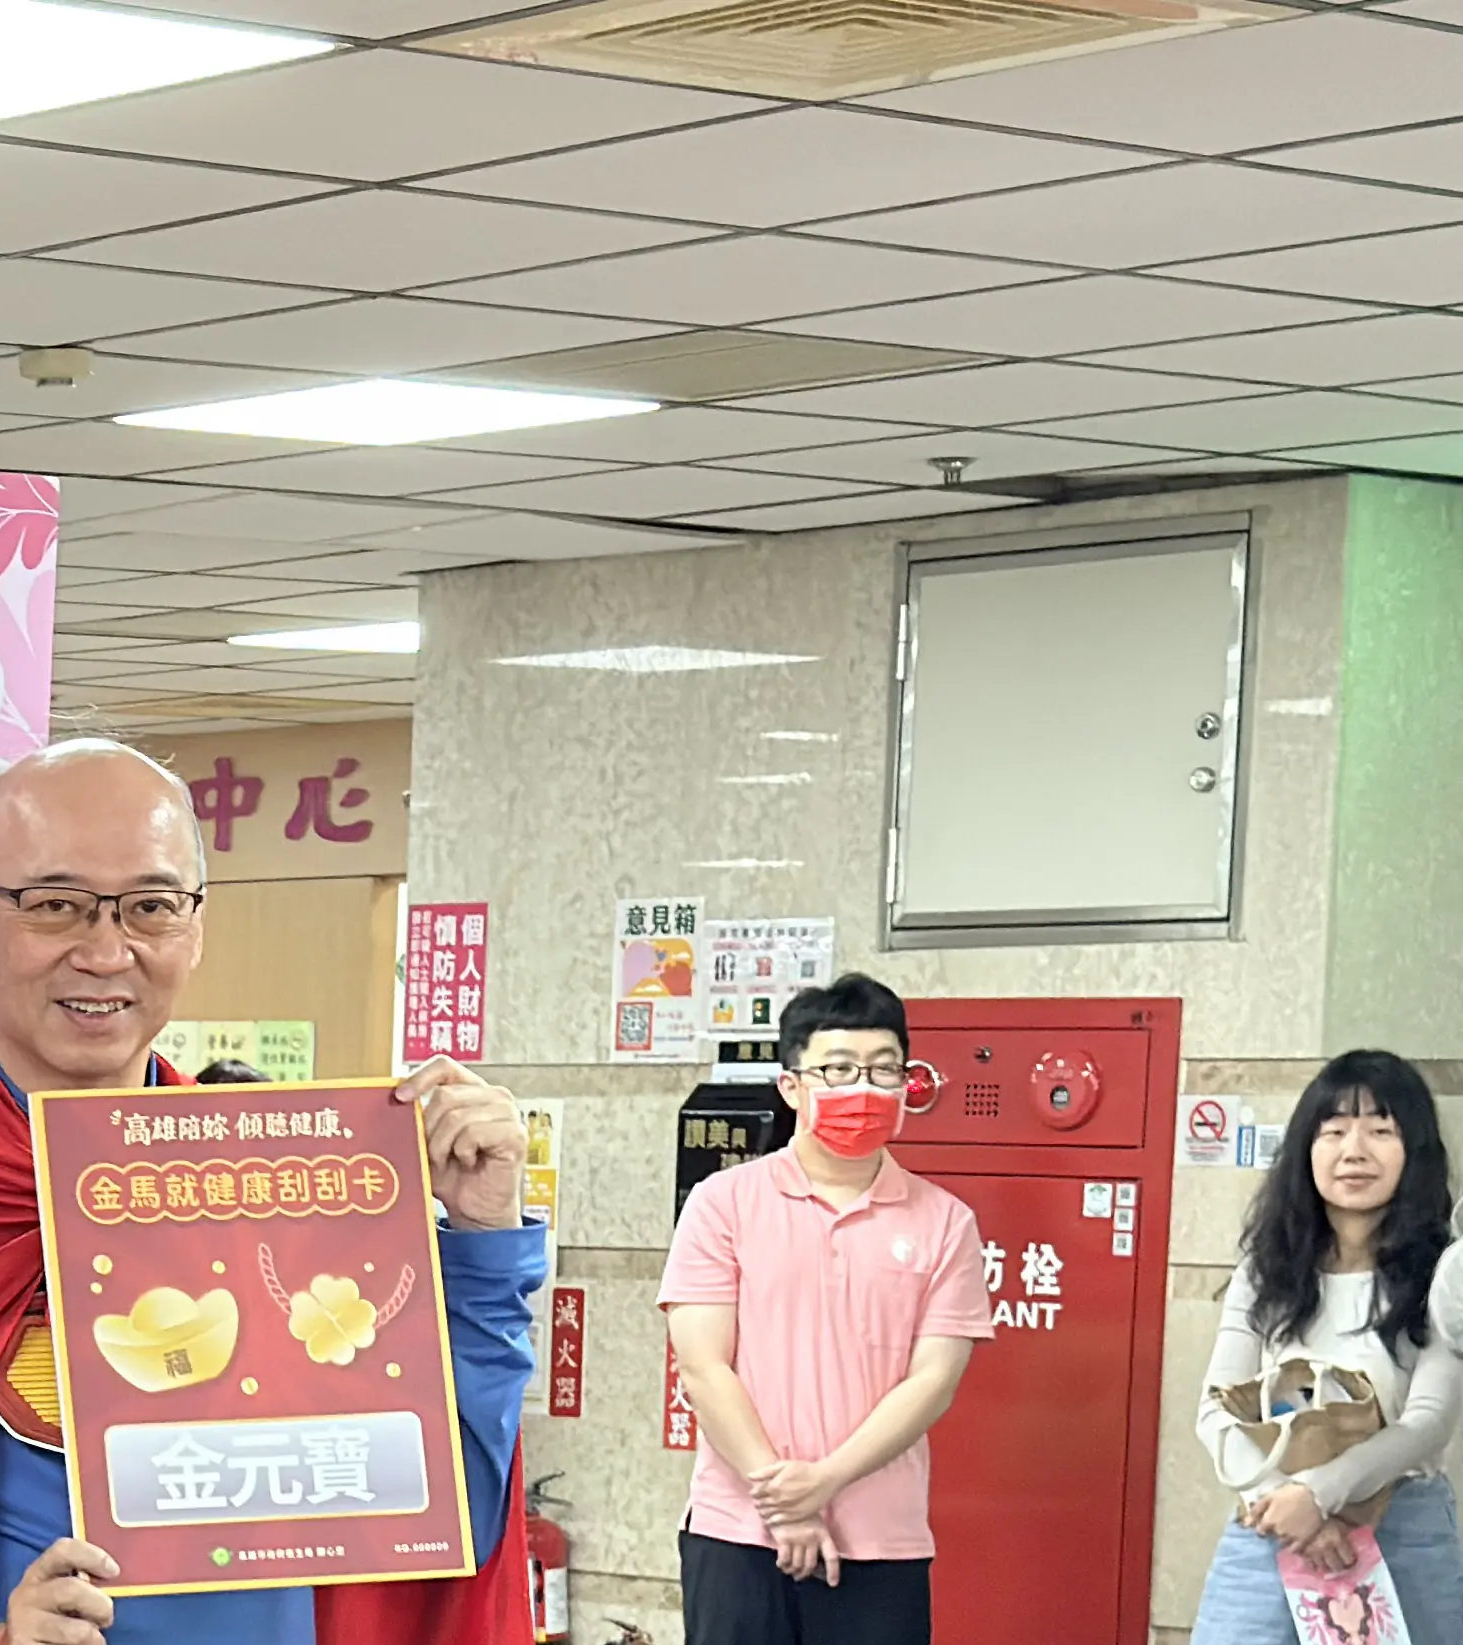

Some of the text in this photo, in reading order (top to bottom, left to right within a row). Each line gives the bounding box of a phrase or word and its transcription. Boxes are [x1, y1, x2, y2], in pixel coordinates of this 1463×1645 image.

[189, 756, 375, 852] 中心
[625, 903, 698, 936] 意見箱
[458, 914, 485, 1053] 個人財物
[89, 1166, 387, 1212] 金馬就健康刮刮卡
[669, 1351, 693, 1447] 火器
[151, 1425, 377, 1512] 金元寶
